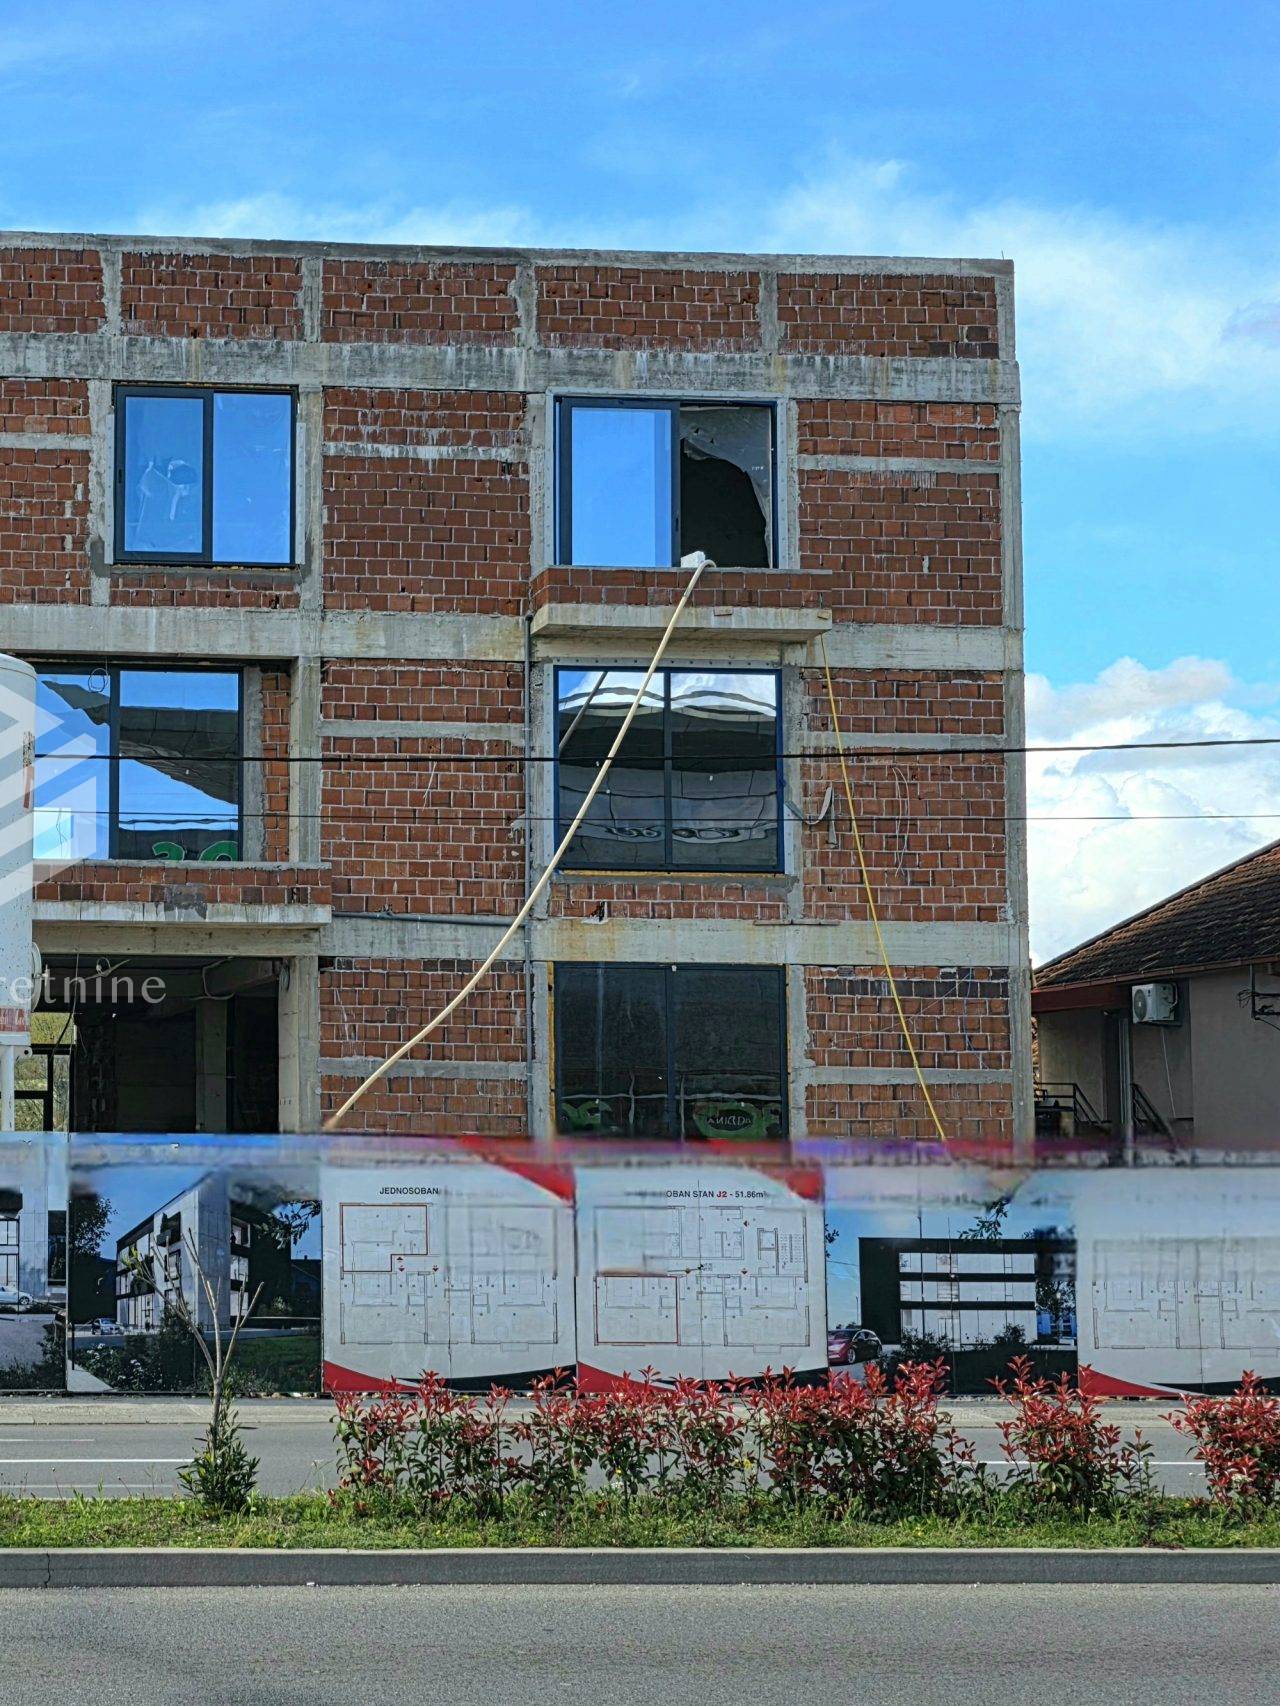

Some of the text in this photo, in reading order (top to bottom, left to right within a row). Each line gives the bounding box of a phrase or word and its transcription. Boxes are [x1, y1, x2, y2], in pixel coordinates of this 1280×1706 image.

[379, 1187, 439, 1195] JEDNOSOBAN
[692, 1190, 714, 1198] STAN
[716, 1190, 728, 1198] J2
